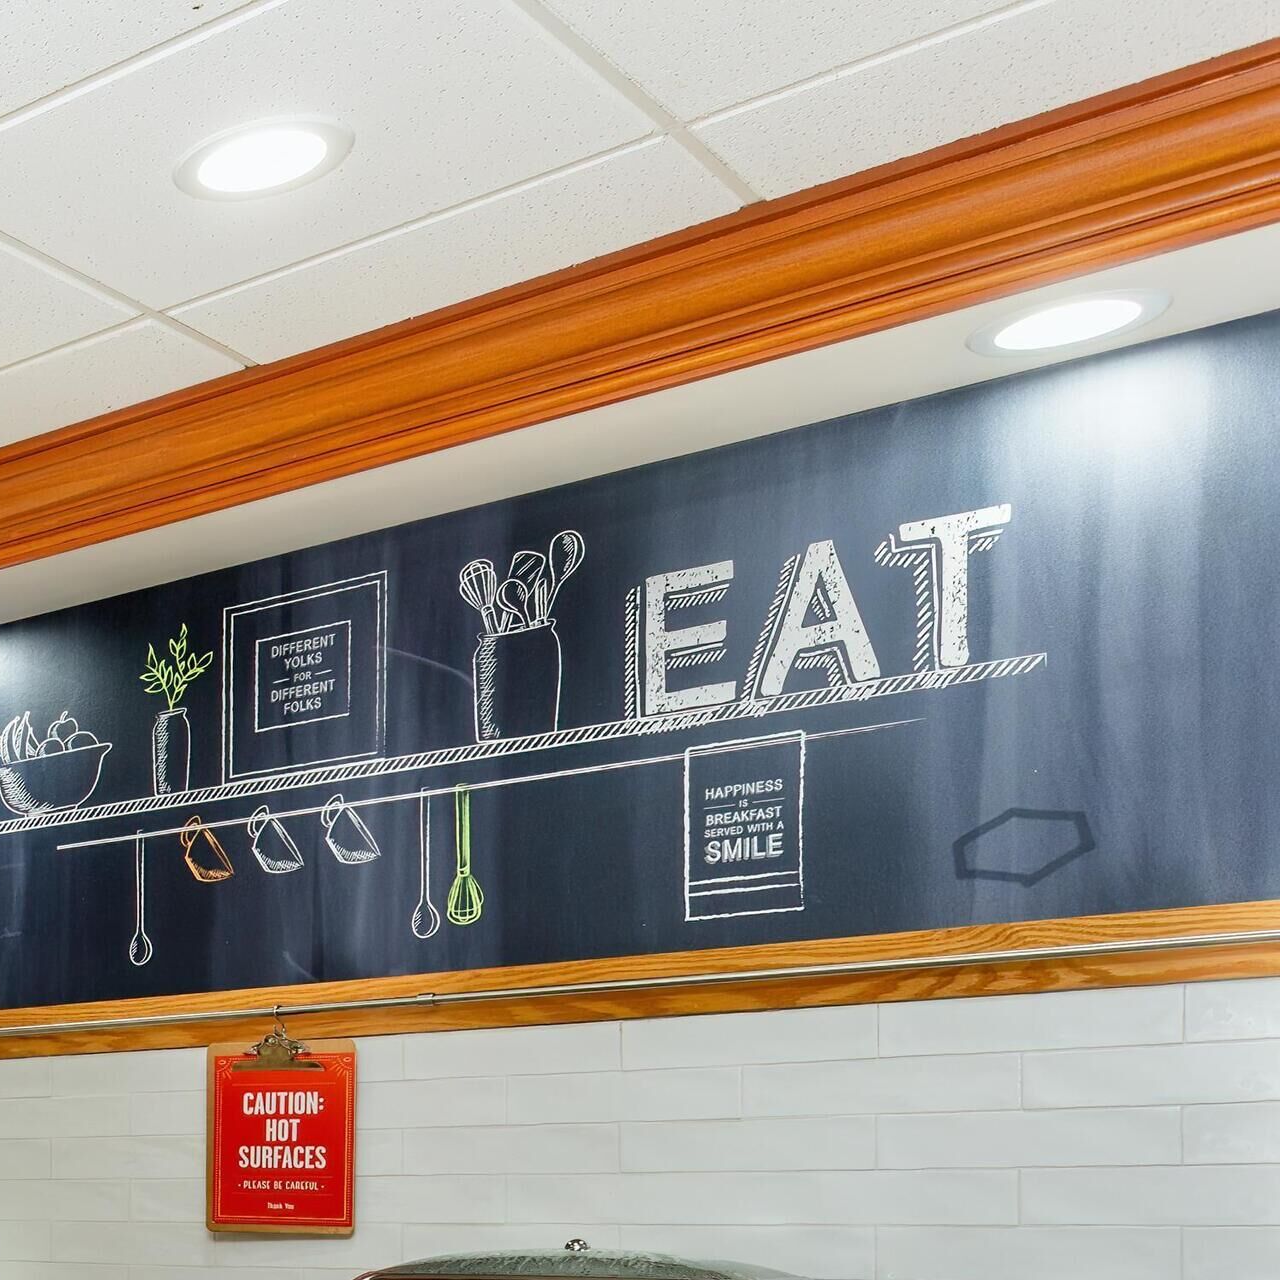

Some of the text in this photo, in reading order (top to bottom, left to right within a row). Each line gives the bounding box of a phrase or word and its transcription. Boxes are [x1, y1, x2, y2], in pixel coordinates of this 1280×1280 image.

[625, 503, 1012, 728] EAT
[271, 633, 336, 658] DIFFERENT
[284, 651, 322, 671] YOLKS
[293, 671, 312, 682] FOR
[270, 679, 336, 703] DIFFERENT
[283, 697, 322, 715] FOLKS
[705, 778, 783, 800] HAPPINESS
[739, 799, 748, 808] IS
[705, 805, 783, 827] BREAKFAST
[704, 820, 784, 838] SERVED WITH A
[704, 833, 784, 864] SMILE
[243, 1091, 324, 1115] CAUTION:
[265, 1119, 300, 1141] HOT
[238, 1145, 327, 1169] SURFACES
[243, 1180, 319, 1191] PLEASE BE CAREFUL
